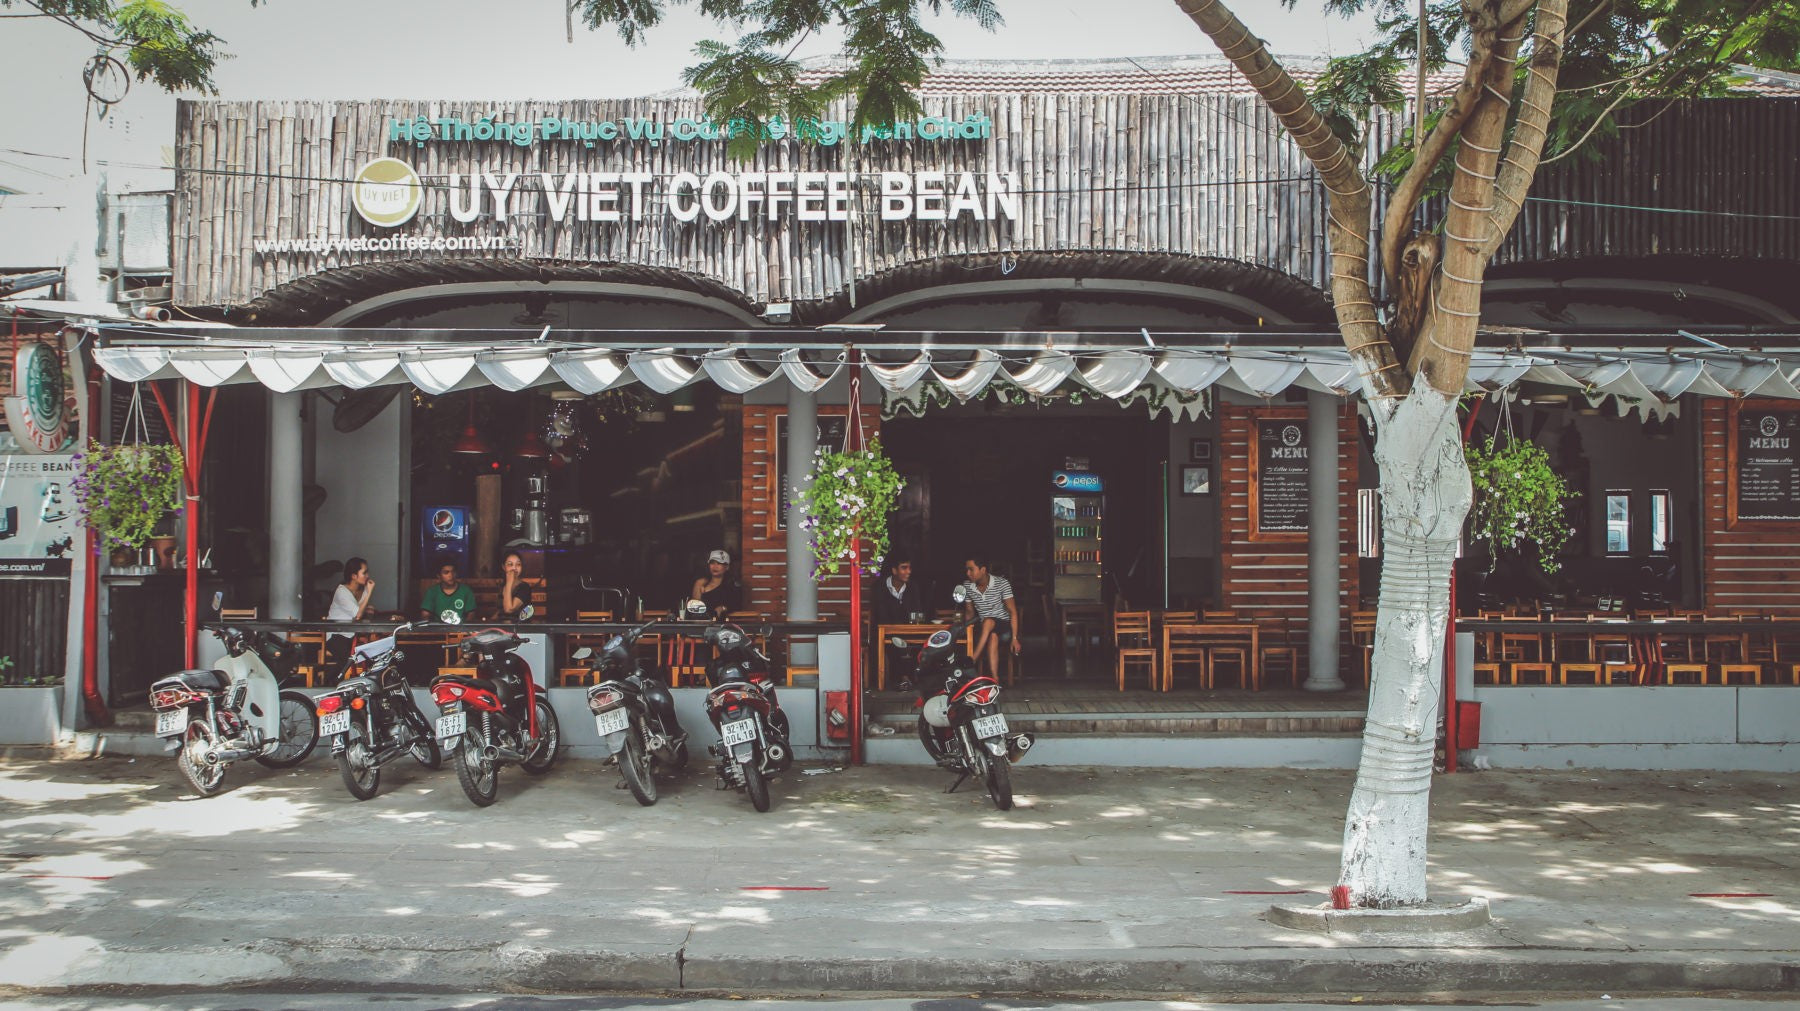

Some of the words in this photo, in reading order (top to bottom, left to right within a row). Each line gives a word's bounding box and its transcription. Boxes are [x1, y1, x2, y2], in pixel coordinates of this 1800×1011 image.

[389, 115, 432, 148] Hệ
[437, 111, 533, 146] Thống
[542, 117, 617, 148] Phục
[624, 117, 664, 147] Vụ
[728, 115, 786, 140] Pê
[917, 111, 990, 140] Chất
[364, 188, 377, 201] UY
[382, 188, 404, 202] VIET
[450, 173, 518, 223] UY
[540, 172, 653, 222] VIET
[668, 172, 857, 222] COFFEE
[882, 171, 1018, 221] BEAN
[254, 232, 505, 257] www.uyvietcoffee.com.vn
[1749, 438, 1790, 449] MENU
[42, 462, 73, 472] BEAN
[1073, 475, 1099, 486] pepsi
[440, 715, 460, 727] 76-F1
[601, 720, 624, 734] 1530
[977, 716, 1000, 728] 76-H1
[440, 724, 461, 737] 1672
[726, 721, 748, 735] 92-H1
